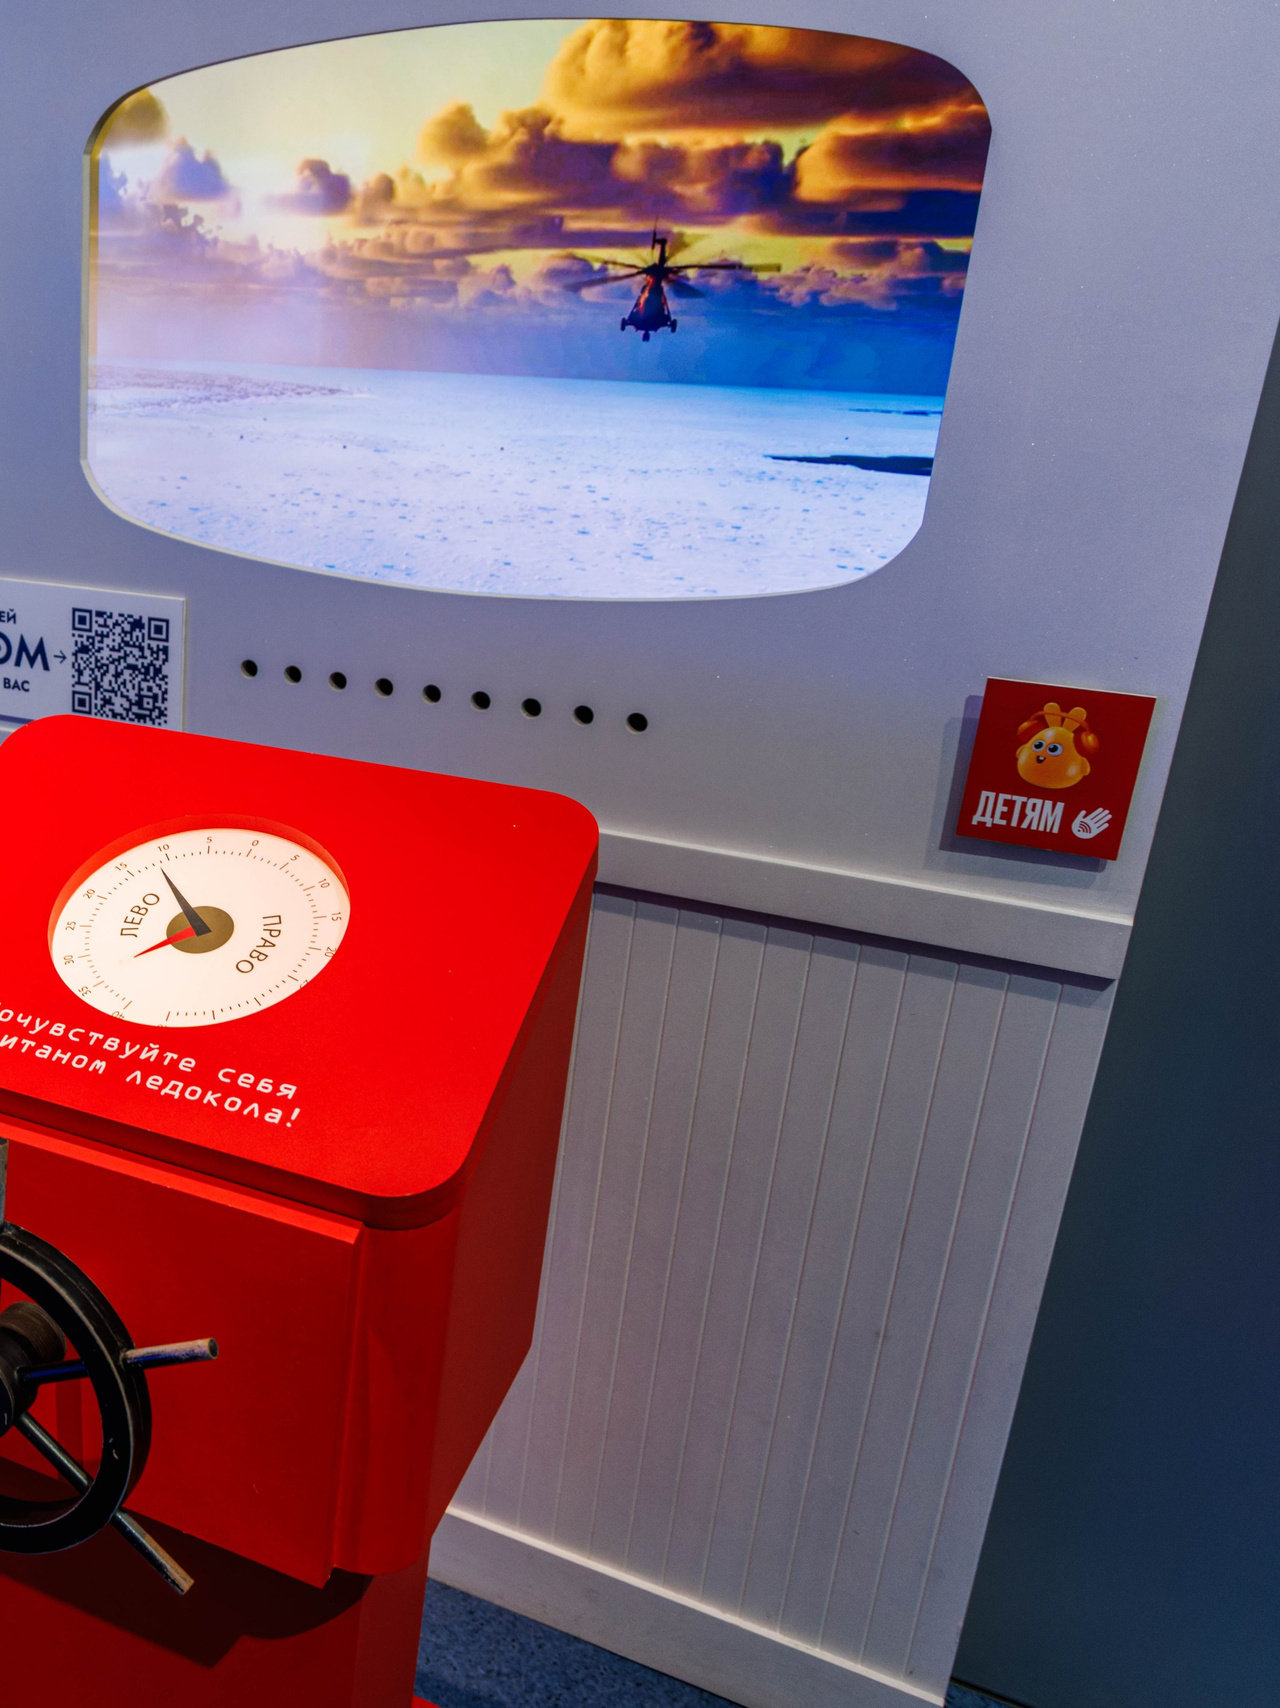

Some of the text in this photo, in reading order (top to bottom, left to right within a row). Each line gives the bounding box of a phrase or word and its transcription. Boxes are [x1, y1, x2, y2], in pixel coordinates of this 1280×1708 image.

[3, 678, 30, 692] ВАС
[971, 790, 1065, 834] ДЕТЯМ
[206, 836, 213, 844] 5
[157, 843, 170, 852] 10
[290, 854, 300, 862] 5
[114, 861, 128, 871] 15
[318, 878, 330, 889] 10
[82, 888, 95, 899] 20
[120, 893, 160, 938] ЛЕВО
[331, 911, 342, 922] 15
[65, 920, 77, 931] 25
[235, 915, 282, 973] ПРАВО
[63, 954, 74, 966] 30
[77, 985, 92, 997] 35
[217, 1066, 298, 1100] себя
[126, 1069, 301, 1128] ледокола!
